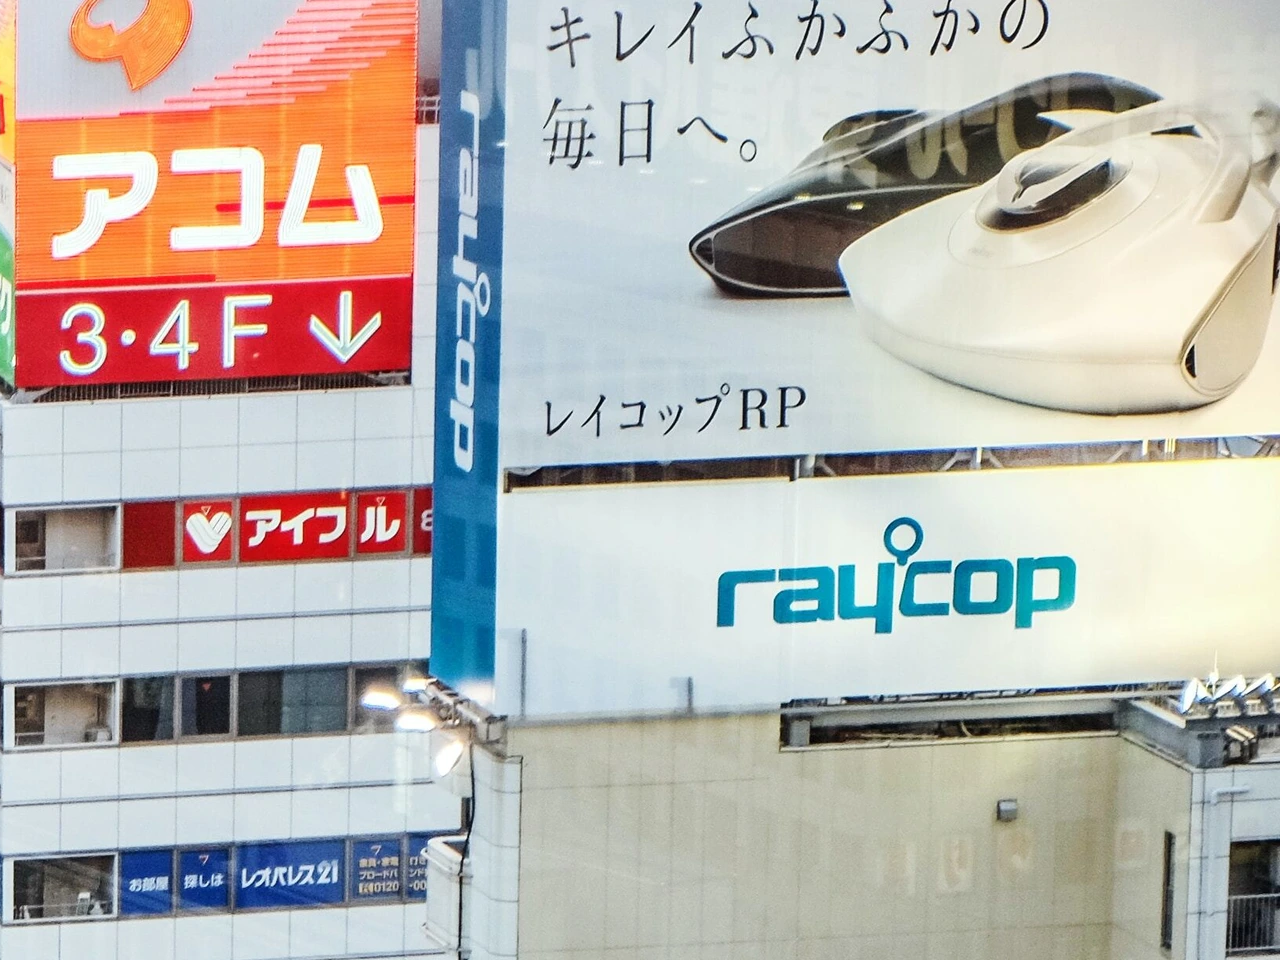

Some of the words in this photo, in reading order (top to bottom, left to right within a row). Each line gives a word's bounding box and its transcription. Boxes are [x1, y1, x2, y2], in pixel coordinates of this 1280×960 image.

[545, 0, 1050, 67] キレイふかふかの
[541, 97, 758, 170] 毎日へ。
[52, 143, 384, 260] アコム
[452, 91, 491, 474] raycop
[544, 384, 807, 438] レイコップRP
[246, 507, 401, 547] アイフル
[716, 517, 1078, 634] raycop
[128, 875, 170, 893] お部屋
[184, 873, 225, 890] 探しは
[241, 861, 339, 889] レオパレス21
